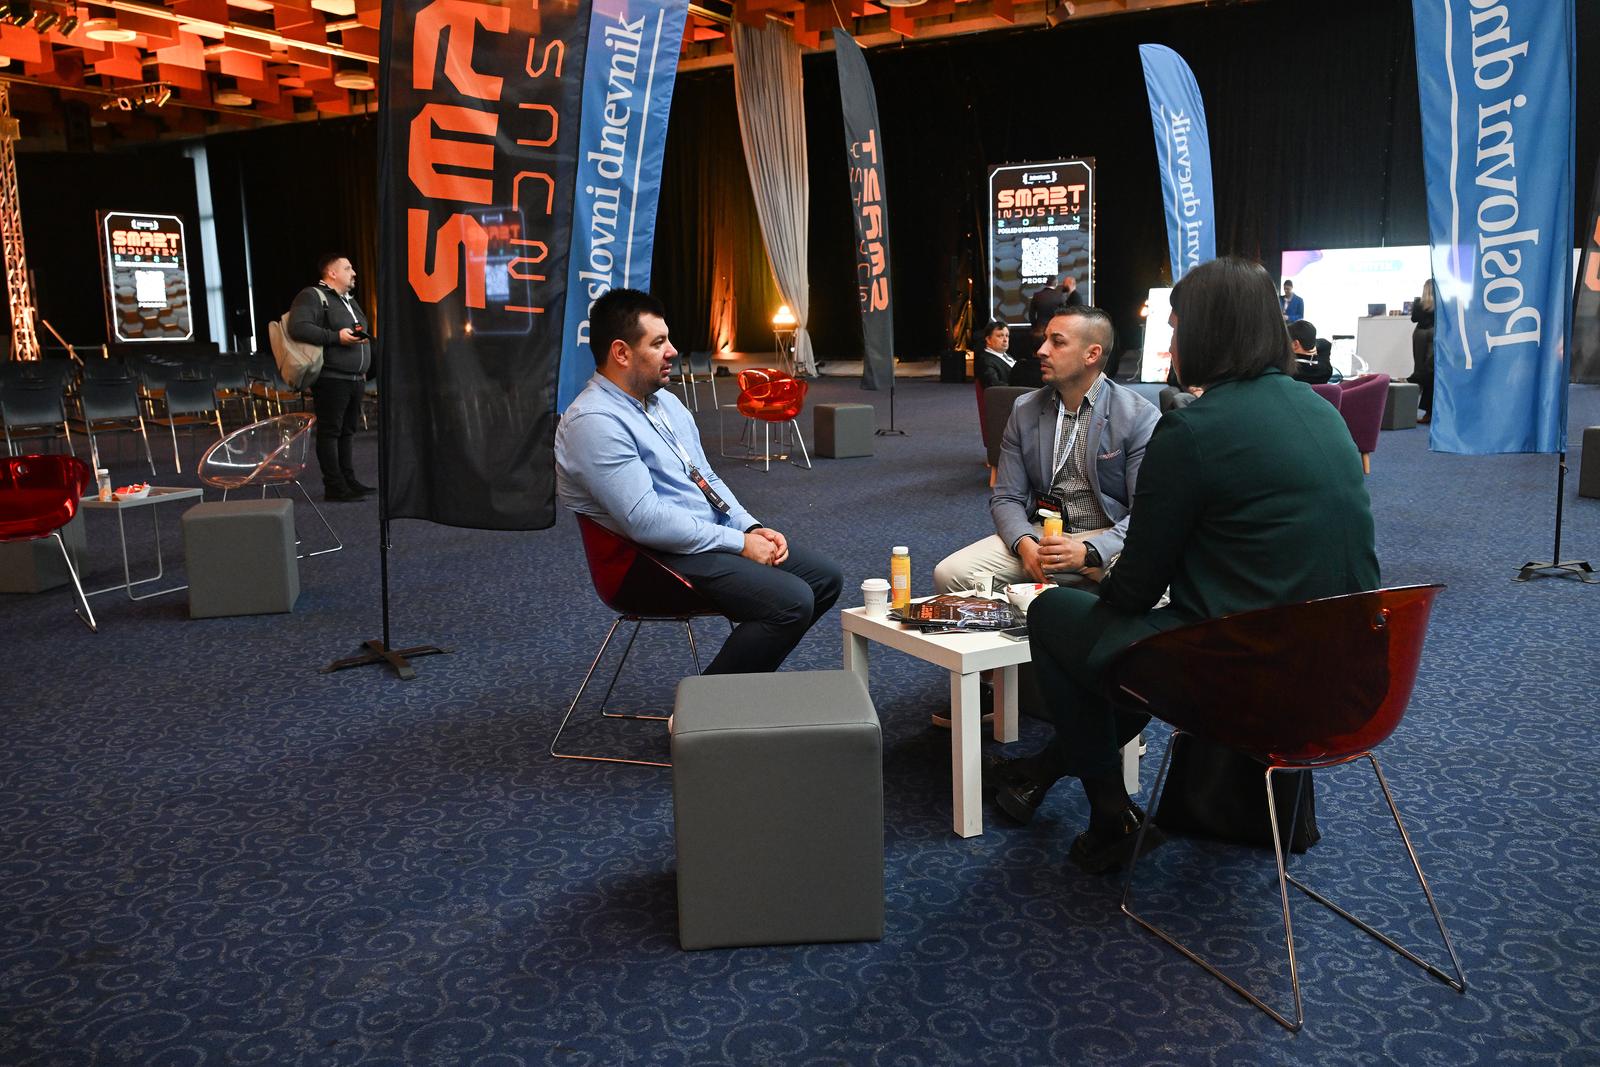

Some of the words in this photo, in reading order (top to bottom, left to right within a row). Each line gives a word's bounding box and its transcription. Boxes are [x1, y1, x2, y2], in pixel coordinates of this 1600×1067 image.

[587, 12, 646, 180] dnevnik
[504, 0, 565, 313] INDUS
[998, 184, 1086, 209] SMART
[998, 205, 1080, 219] INDUSTRY
[112, 230, 180, 249] SMART
[113, 246, 178, 257] INDUSTRY
[577, 186, 621, 347] slovni
